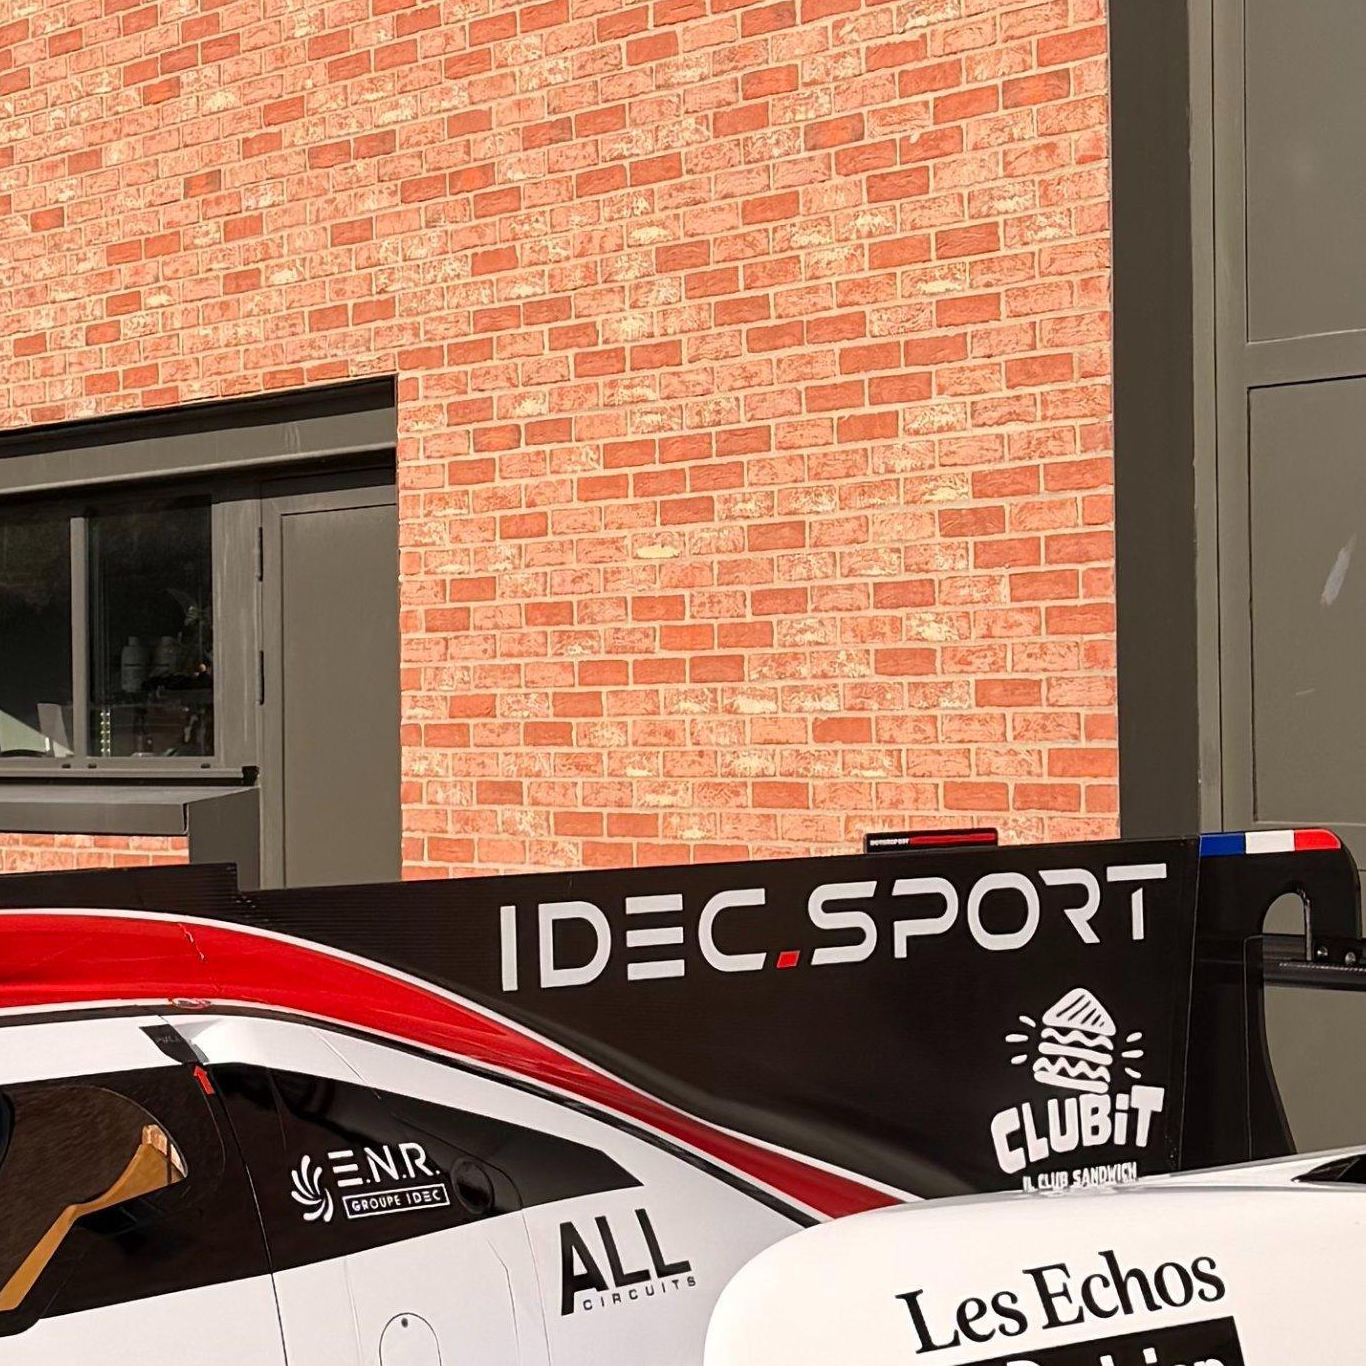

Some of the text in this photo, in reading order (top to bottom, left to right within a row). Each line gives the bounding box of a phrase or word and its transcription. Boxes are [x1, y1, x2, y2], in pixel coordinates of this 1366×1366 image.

[1038, 1171, 1069, 1191] CLUB
[1072, 1161, 1138, 1188] SANDWICH
[351, 1188, 444, 1213] GROUPE IDEC
[560, 1208, 693, 1316] ALL
[582, 1275, 697, 1311] CIRCUITS
[895, 1250, 1227, 1354] Les Echos
